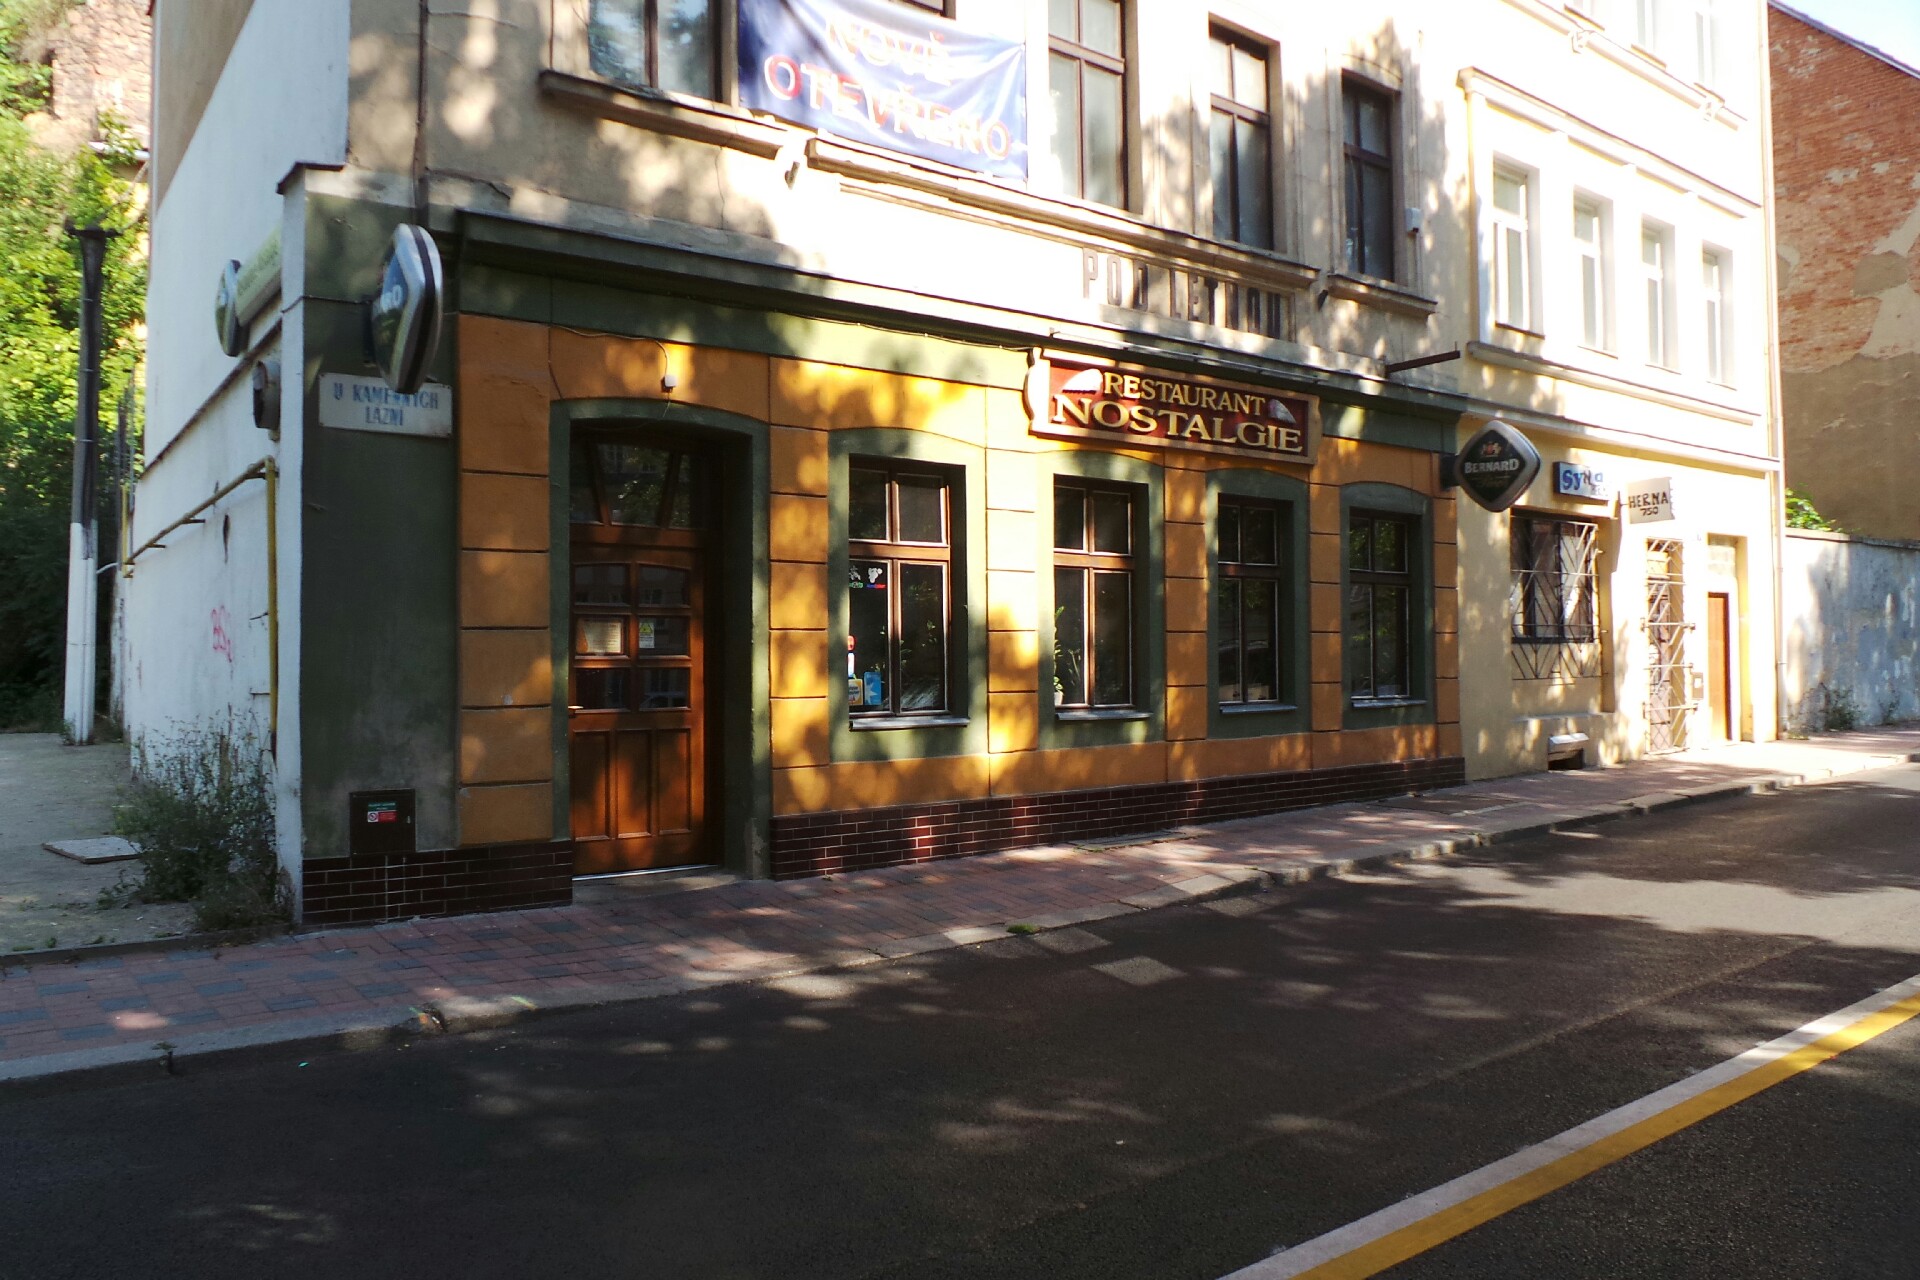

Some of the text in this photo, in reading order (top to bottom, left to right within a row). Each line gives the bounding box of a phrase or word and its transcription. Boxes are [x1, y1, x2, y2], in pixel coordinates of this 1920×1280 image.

[763, 54, 1013, 161] OTEVŘENO
[1103, 371, 1266, 416] RESTAURANT
[1050, 393, 1304, 453] NOSTALGIE
[1464, 458, 1520, 474] BERNARD
[1628, 491, 1669, 508] HERNA
[1639, 506, 1659, 516] 750
